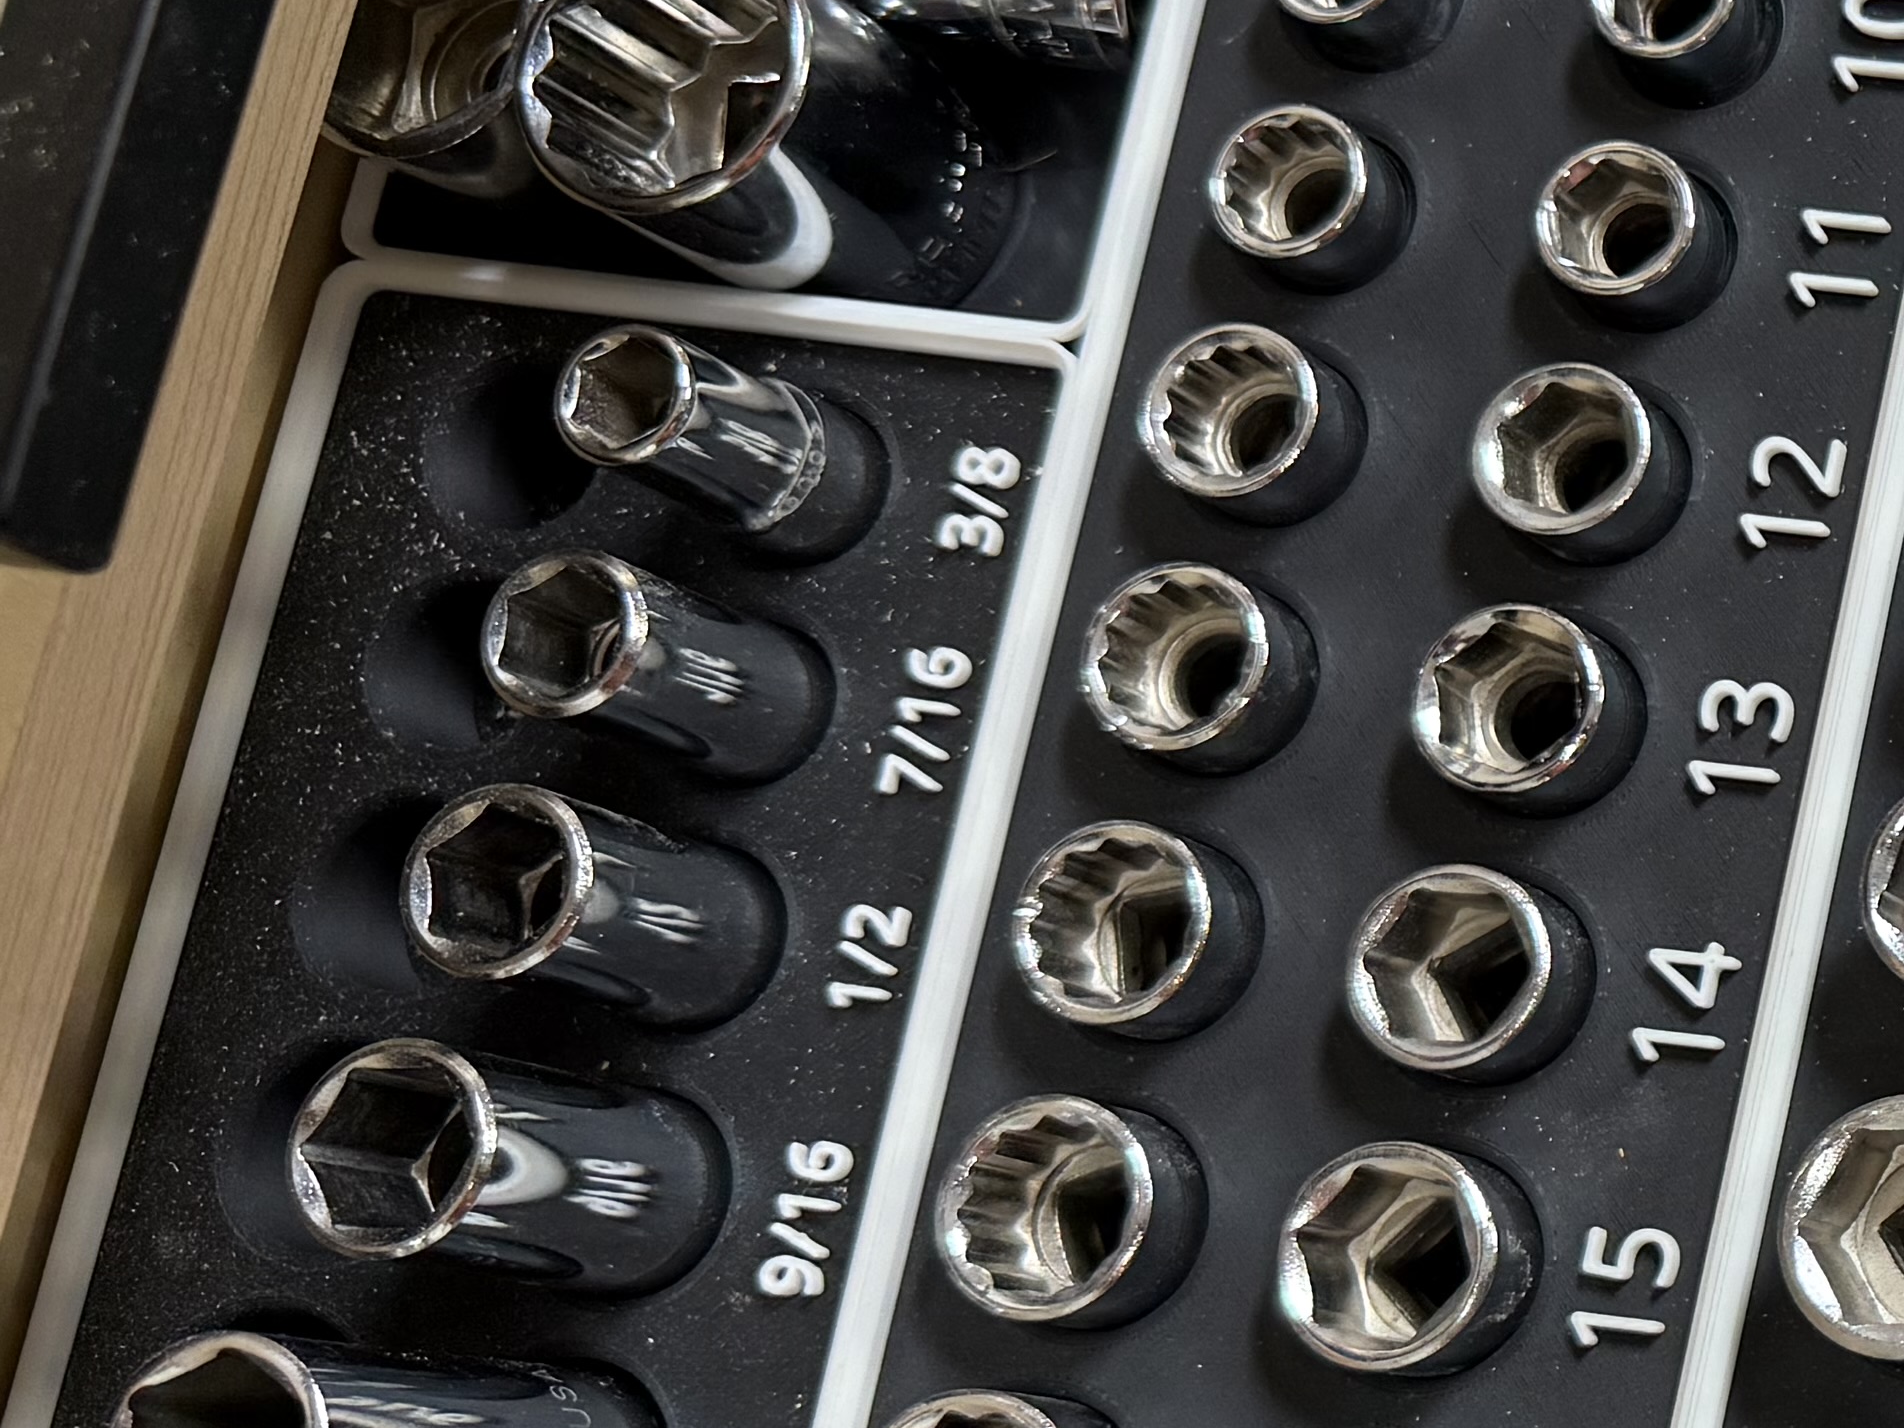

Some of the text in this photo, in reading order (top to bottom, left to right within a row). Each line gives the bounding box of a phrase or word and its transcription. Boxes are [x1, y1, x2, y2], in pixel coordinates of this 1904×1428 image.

[1788, 208, 1892, 307] 11
[936, 445, 1021, 556] 3/8
[1739, 435, 1848, 548] 12
[875, 646, 973, 794] 7/16
[1687, 679, 1795, 795] 13
[826, 903, 913, 1007] 1/2
[1631, 941, 1743, 1062] 14
[757, 1140, 854, 1296] 9/16
[1569, 1226, 1681, 1346] 15
